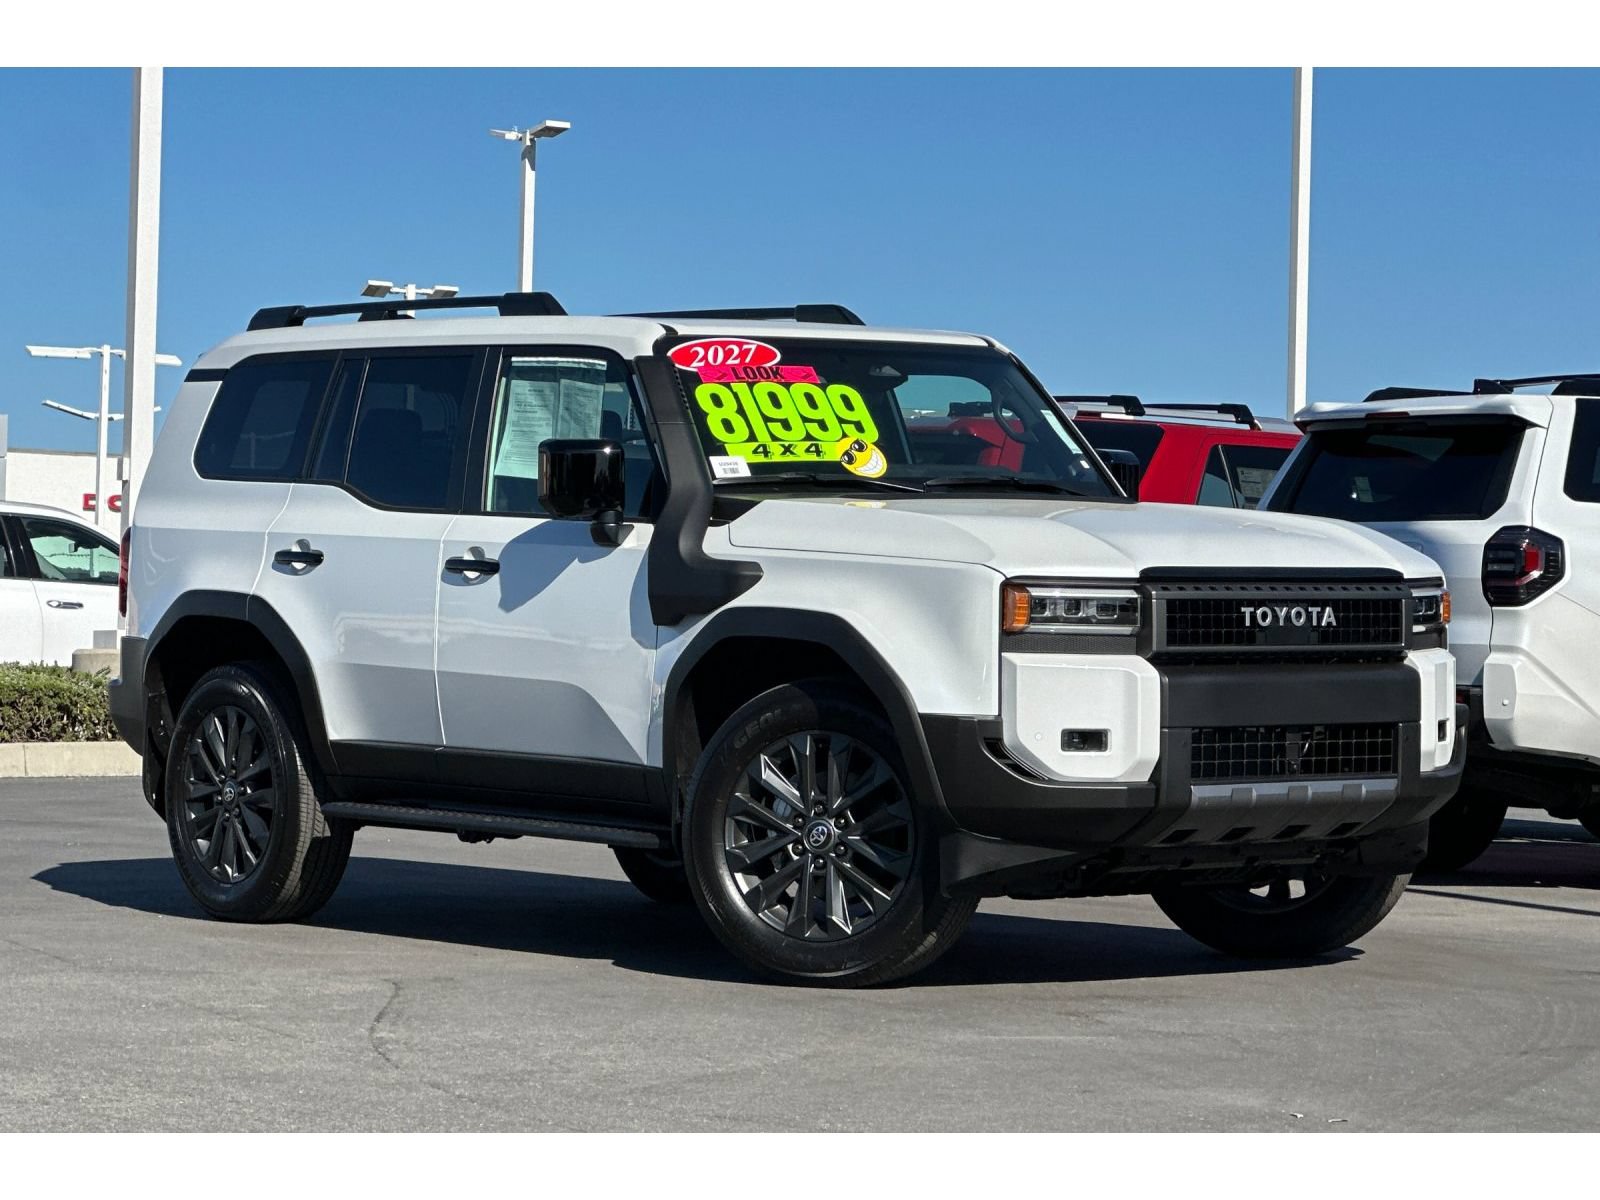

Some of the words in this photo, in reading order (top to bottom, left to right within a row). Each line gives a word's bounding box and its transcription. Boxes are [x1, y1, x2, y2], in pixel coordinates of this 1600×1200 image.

[690, 343, 757, 368] 2027
[730, 366, 784, 381] LOOK
[695, 381, 879, 443] 81999
[1240, 606, 1337, 627] TOYOTA
